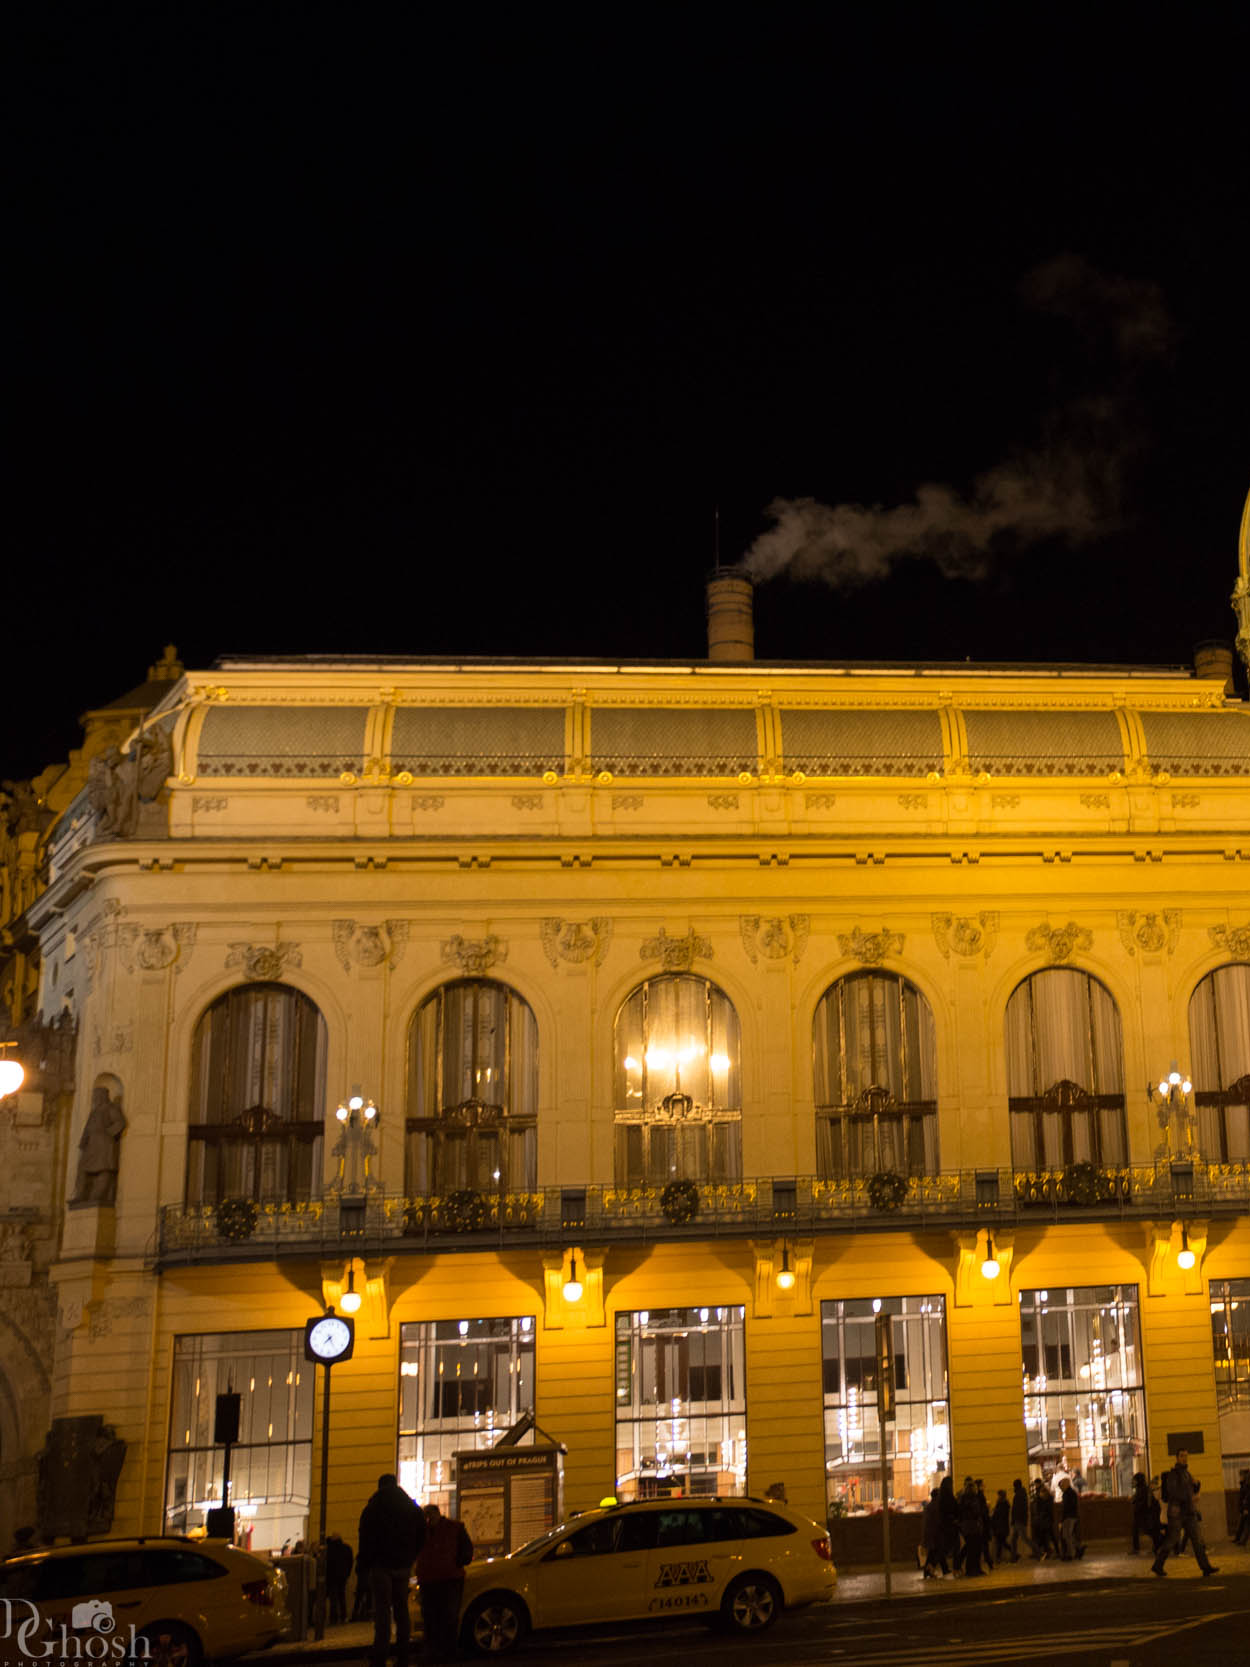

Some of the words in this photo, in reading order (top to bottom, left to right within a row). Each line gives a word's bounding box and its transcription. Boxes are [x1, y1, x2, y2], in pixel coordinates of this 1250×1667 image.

[489, 1458, 505, 1467] OUT
[518, 1455, 547, 1465] PRAGUE
[653, 1560, 715, 1589] AAA
